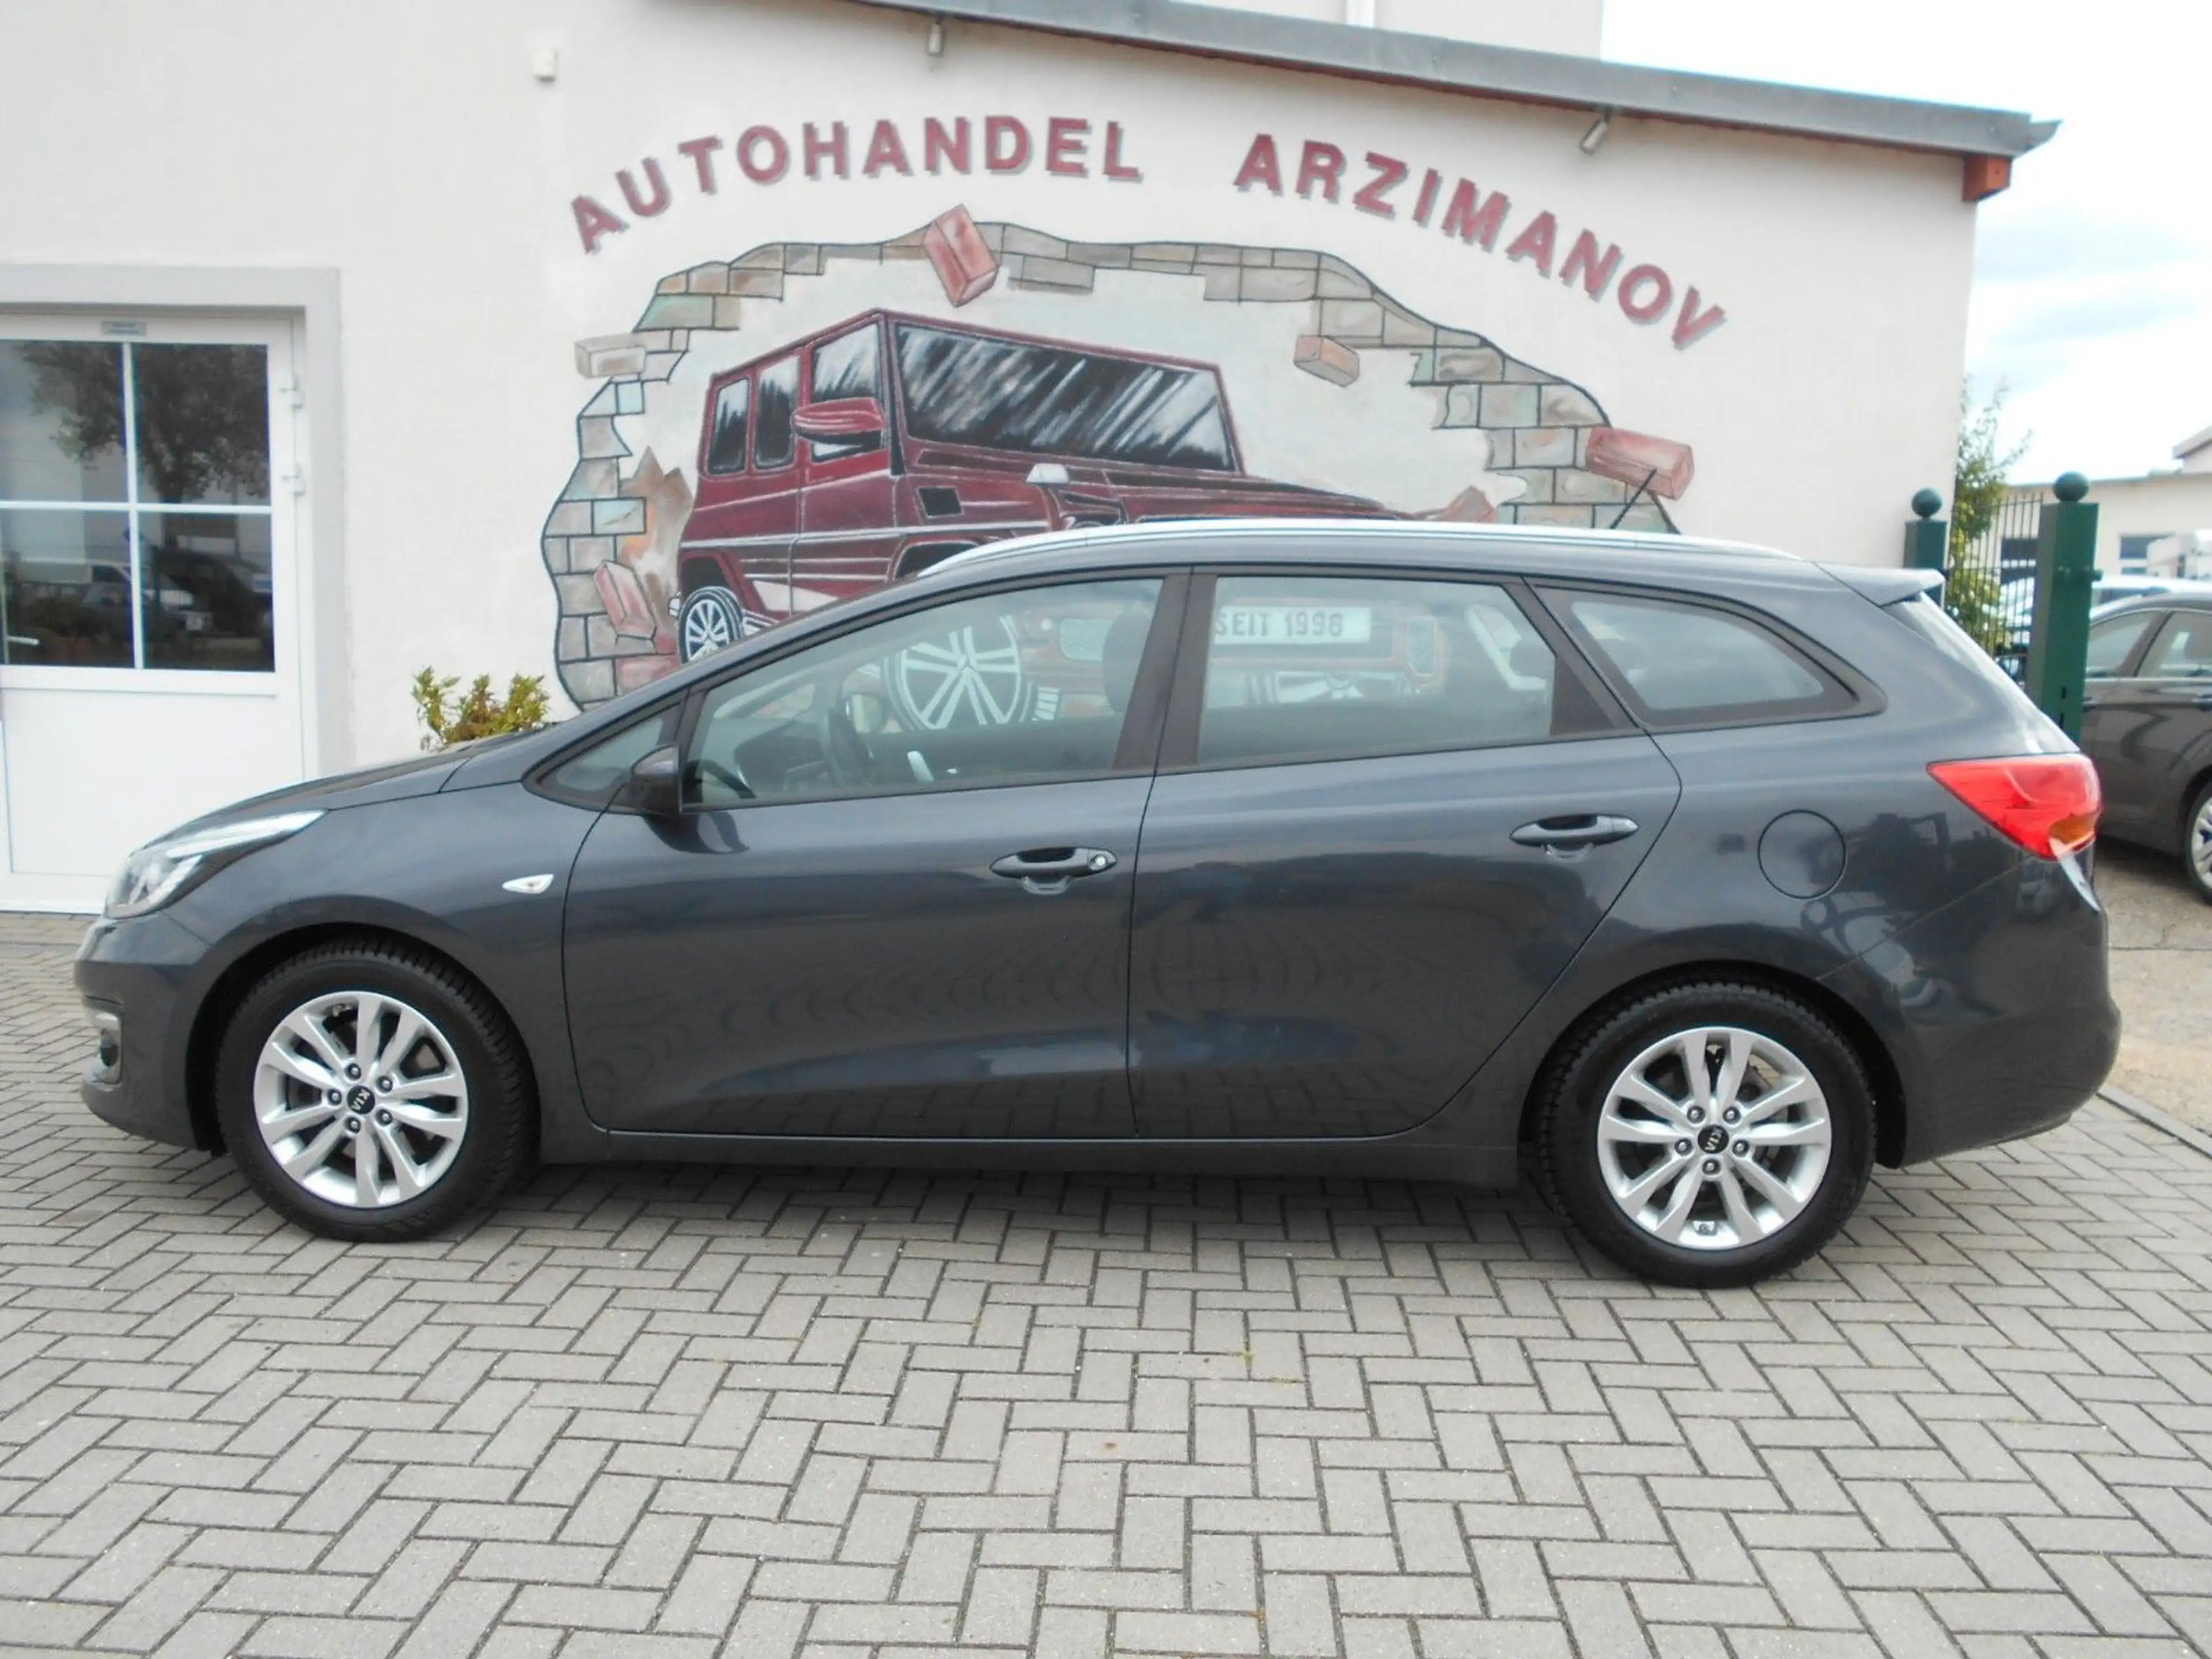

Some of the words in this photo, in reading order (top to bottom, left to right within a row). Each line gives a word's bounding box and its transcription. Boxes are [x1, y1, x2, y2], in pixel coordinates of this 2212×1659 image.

[570, 115, 1142, 255] AUTOHANDEL
[1233, 133, 1726, 350] ARZIMANOV
[1215, 611, 1271, 636] SEIT
[351, 1088, 372, 1111] KIA
